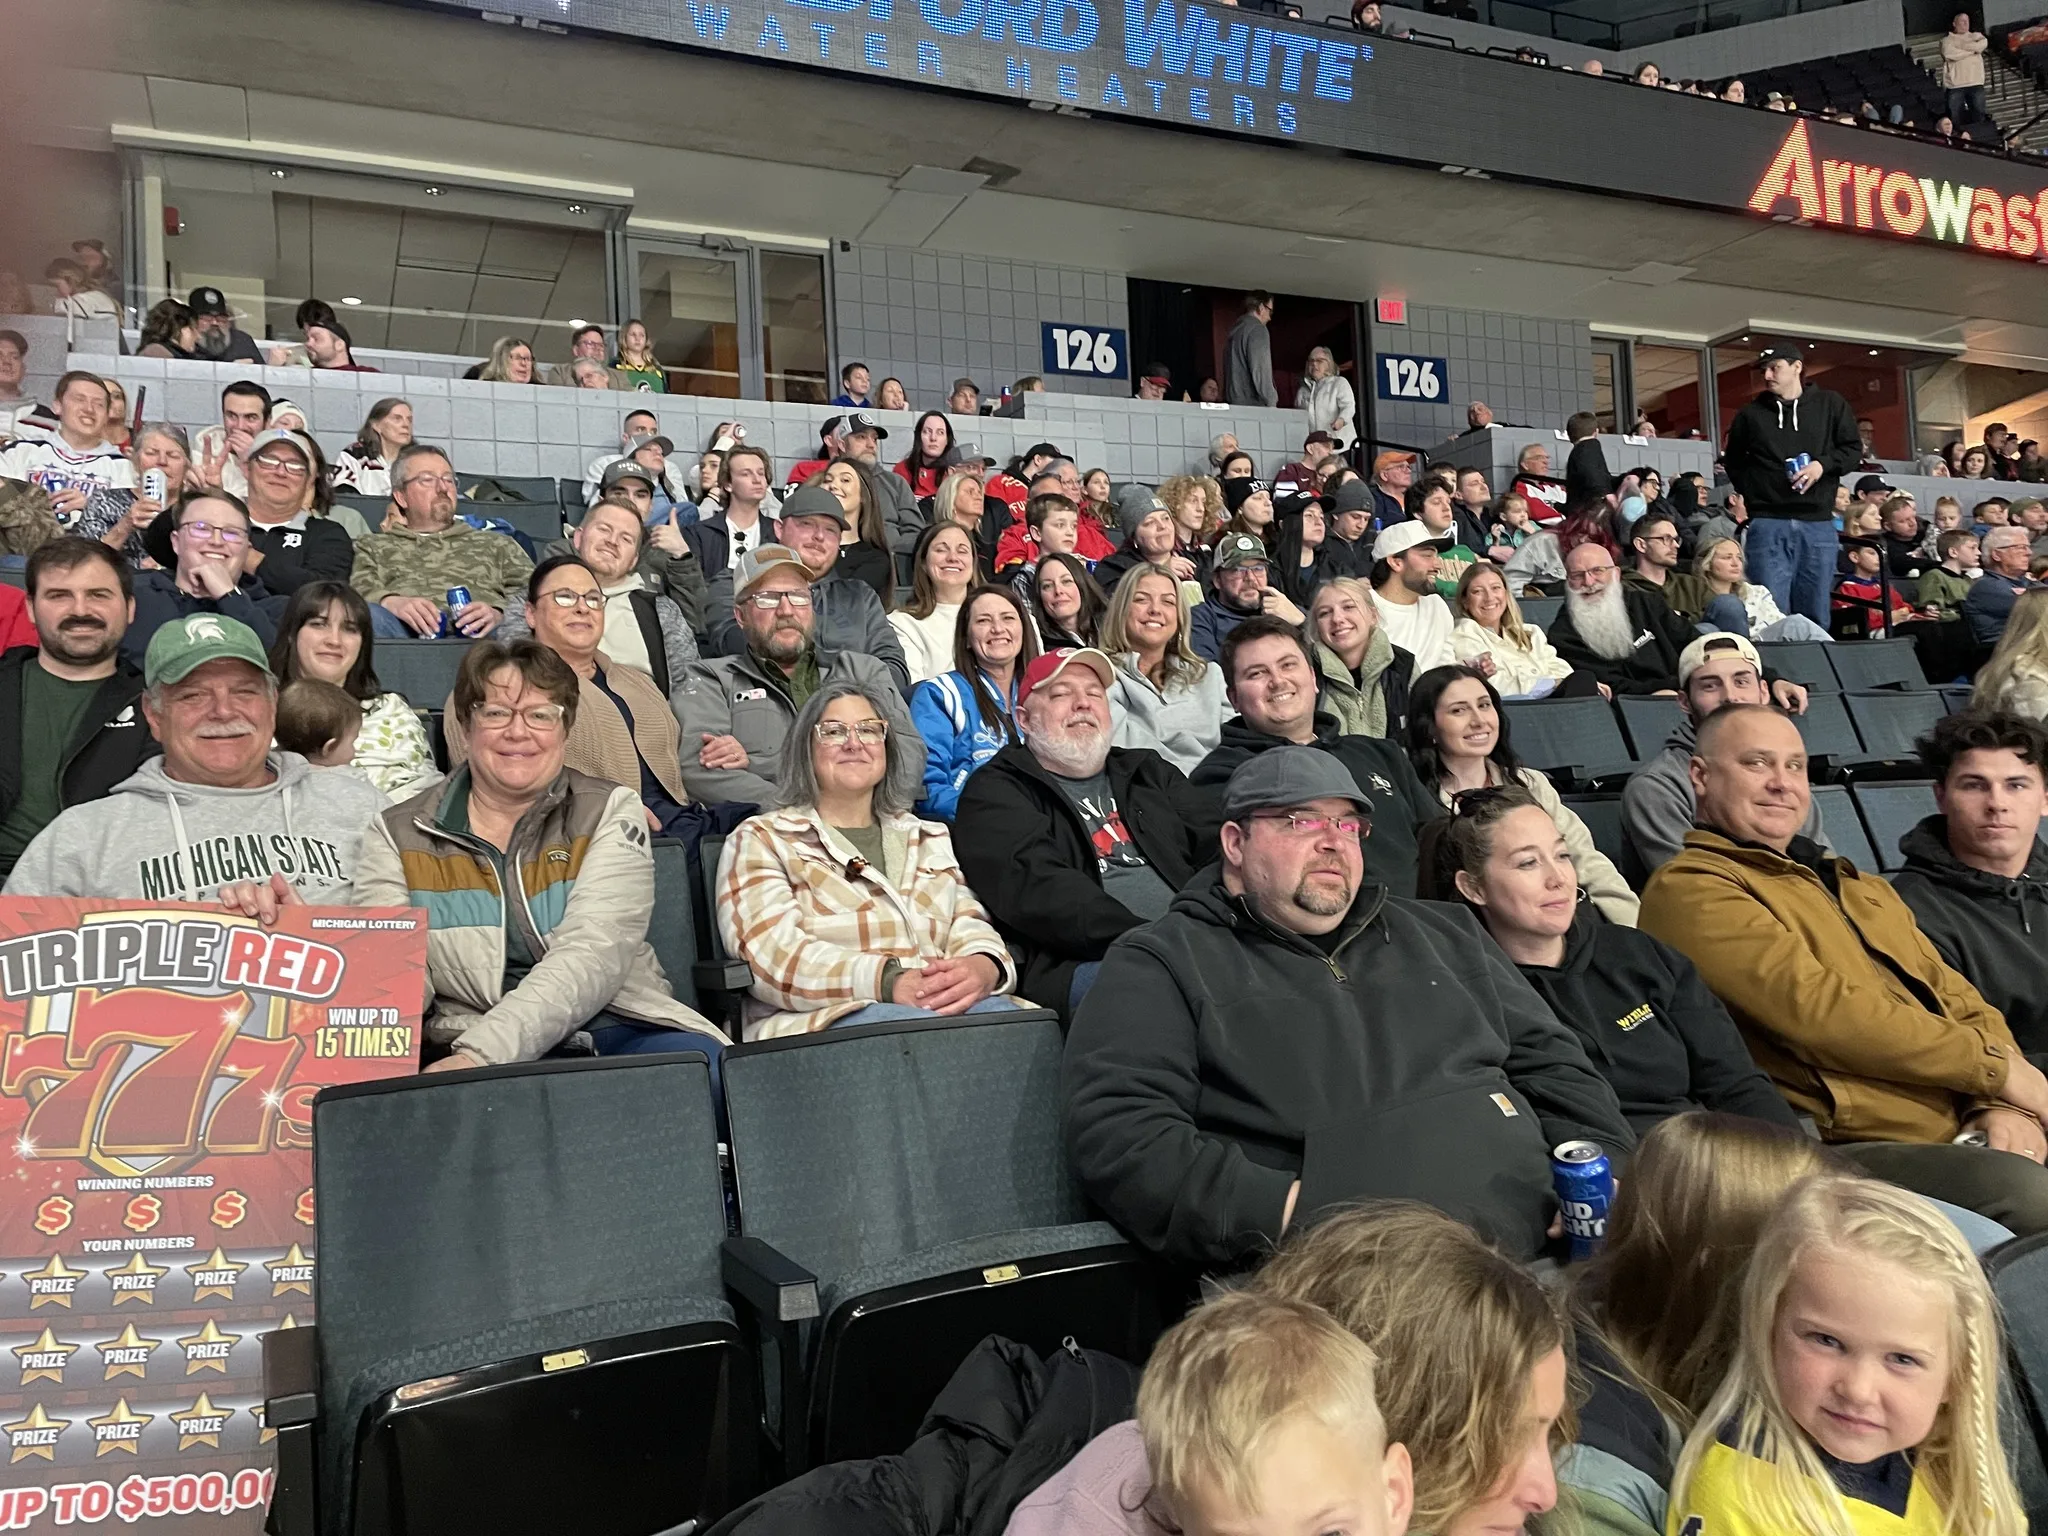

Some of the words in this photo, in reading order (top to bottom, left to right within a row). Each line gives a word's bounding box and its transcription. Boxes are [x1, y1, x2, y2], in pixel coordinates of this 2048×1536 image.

[1125, 0, 1358, 102] WHITE
[685, 0, 944, 77] WATER
[1006, 55, 1297, 134] HEATERS
[1052, 328, 1117, 374] 126
[1385, 358, 1441, 399] 126
[1008, 500, 1027, 514] FU
[139, 833, 272, 901] MICHIGAN
[270, 834, 349, 881] STATE
[311, 918, 367, 930] MICHIGAN
[368, 919, 417, 931] LOTTERY
[0, 922, 220, 996] TRIPLE
[220, 926, 345, 999] RED
[328, 1008, 358, 1026] WIN
[359, 1008, 379, 1025] UP
[380, 1008, 399, 1025] TO
[315, 1027, 339, 1057] 15
[343, 1027, 412, 1056] TIMES!
[77, 1177, 142, 1190] WINNING
[144, 1175, 214, 1190] NUMBERS
[1561, 1198, 1593, 1220] UD
[82, 1239, 121, 1252] YOUR
[123, 1237, 196, 1251] NUMBERS
[31, 1278, 76, 1294] PRIZE
[112, 1274, 157, 1290] PRIZE
[193, 1270, 237, 1286] PRIZE
[271, 1267, 313, 1283] PRIZE
[21, 1352, 67, 1369] PRIZE
[104, 1348, 148, 1365] PRIZE
[186, 1343, 231, 1360] PRIZE
[11, 1429, 58, 1447] PRIZE
[96, 1423, 141, 1440] PRIZE
[179, 1417, 223, 1434] PRIZE
[51, 1481, 114, 1525] TO
[116, 1467, 273, 1523] $500,0
